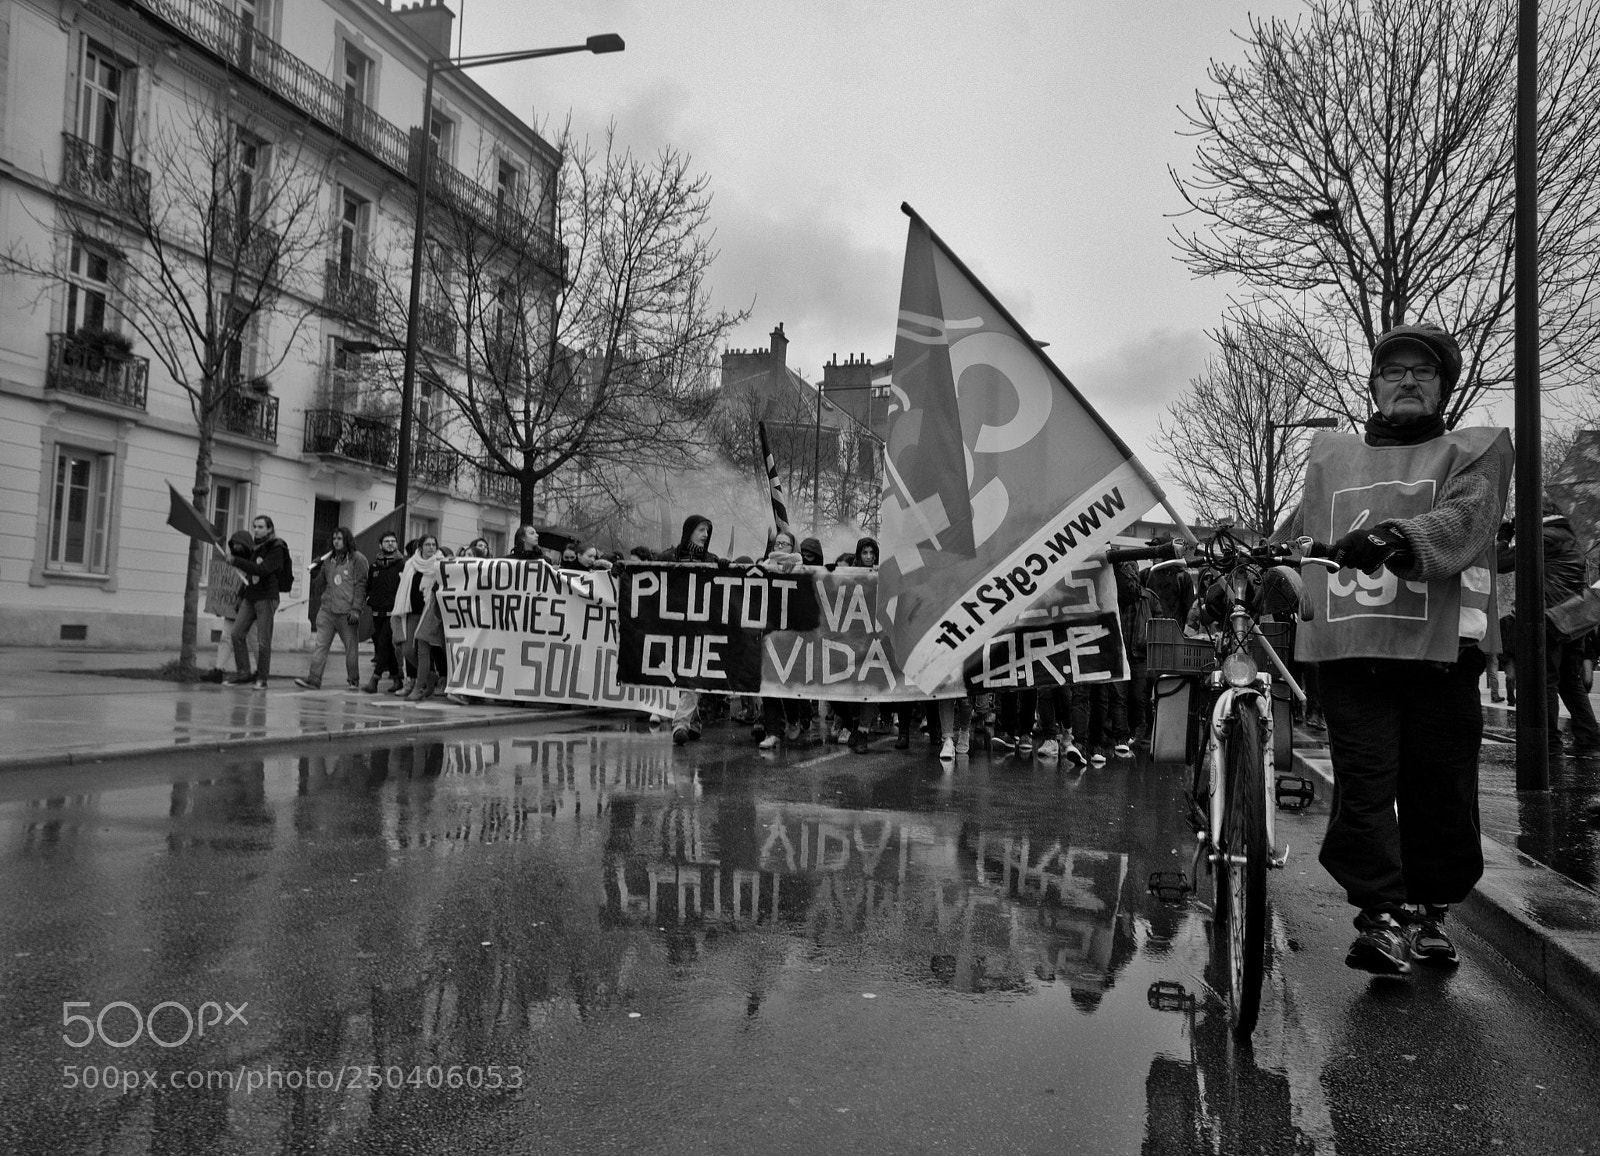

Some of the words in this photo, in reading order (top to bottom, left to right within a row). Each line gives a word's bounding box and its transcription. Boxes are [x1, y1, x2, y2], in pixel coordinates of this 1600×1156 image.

[369, 500, 378, 511] 17
[630, 568, 798, 630] PLUTÔT
[446, 637, 506, 695] TOUS
[641, 634, 728, 684] QUE
